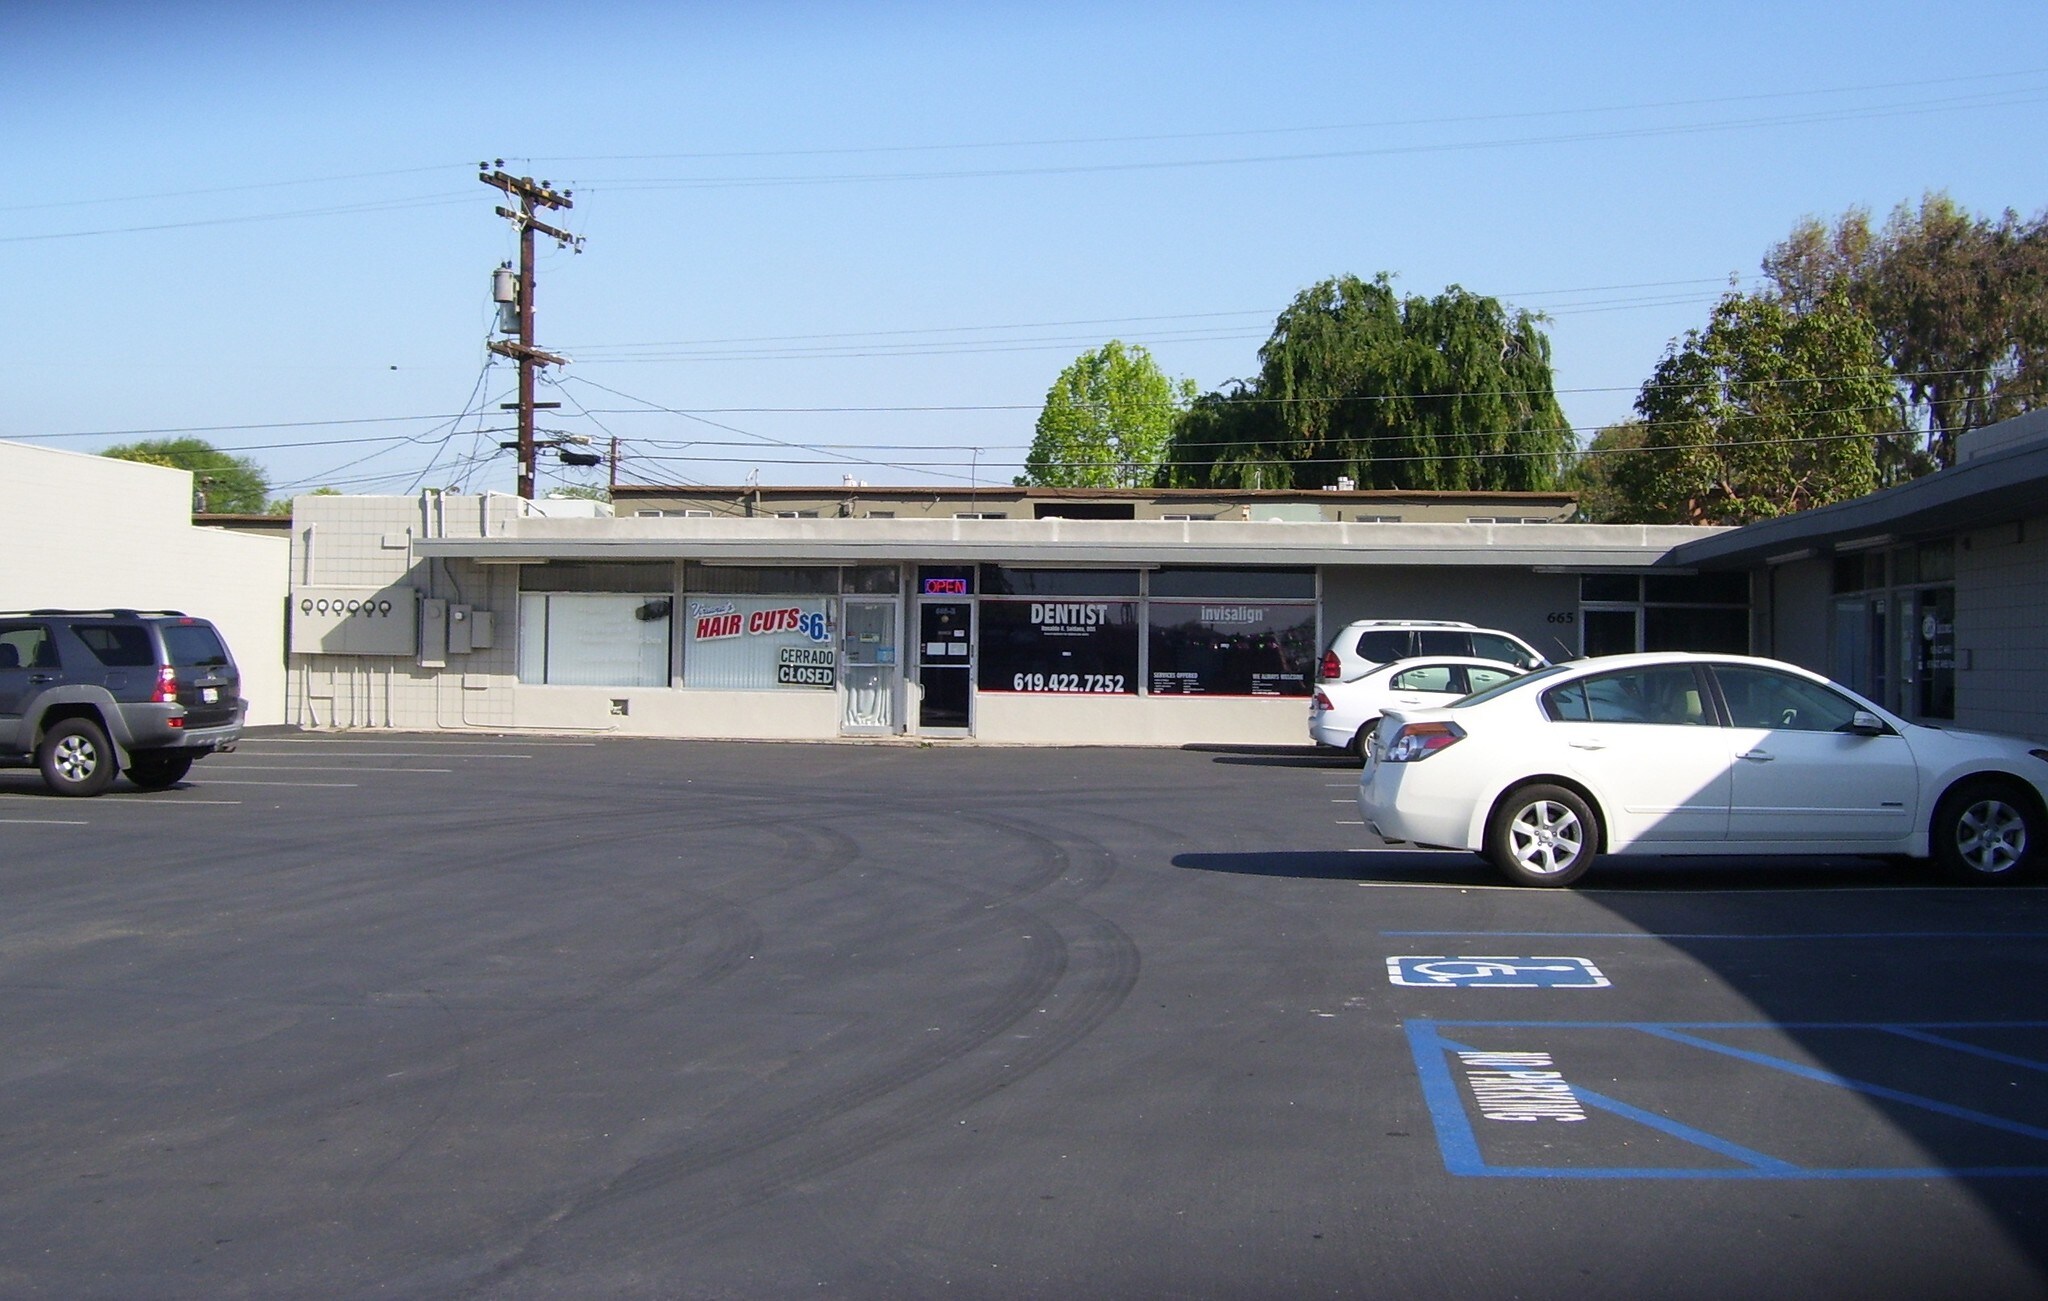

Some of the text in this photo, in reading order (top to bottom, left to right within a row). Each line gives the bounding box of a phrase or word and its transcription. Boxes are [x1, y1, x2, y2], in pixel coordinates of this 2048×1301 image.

[926, 580, 965, 593] OPEN
[696, 614, 742, 639] HAIR
[749, 608, 800, 633] CUTS
[1031, 604, 1107, 625] DENTIST
[1201, 606, 1264, 624] invisalign
[1547, 612, 1574, 624] 665
[780, 648, 834, 665] CERRADO
[779, 667, 833, 684] CLOSED
[1013, 673, 1124, 692] 619.422.7252
[1457, 1051, 1588, 1122] NO PARKING
